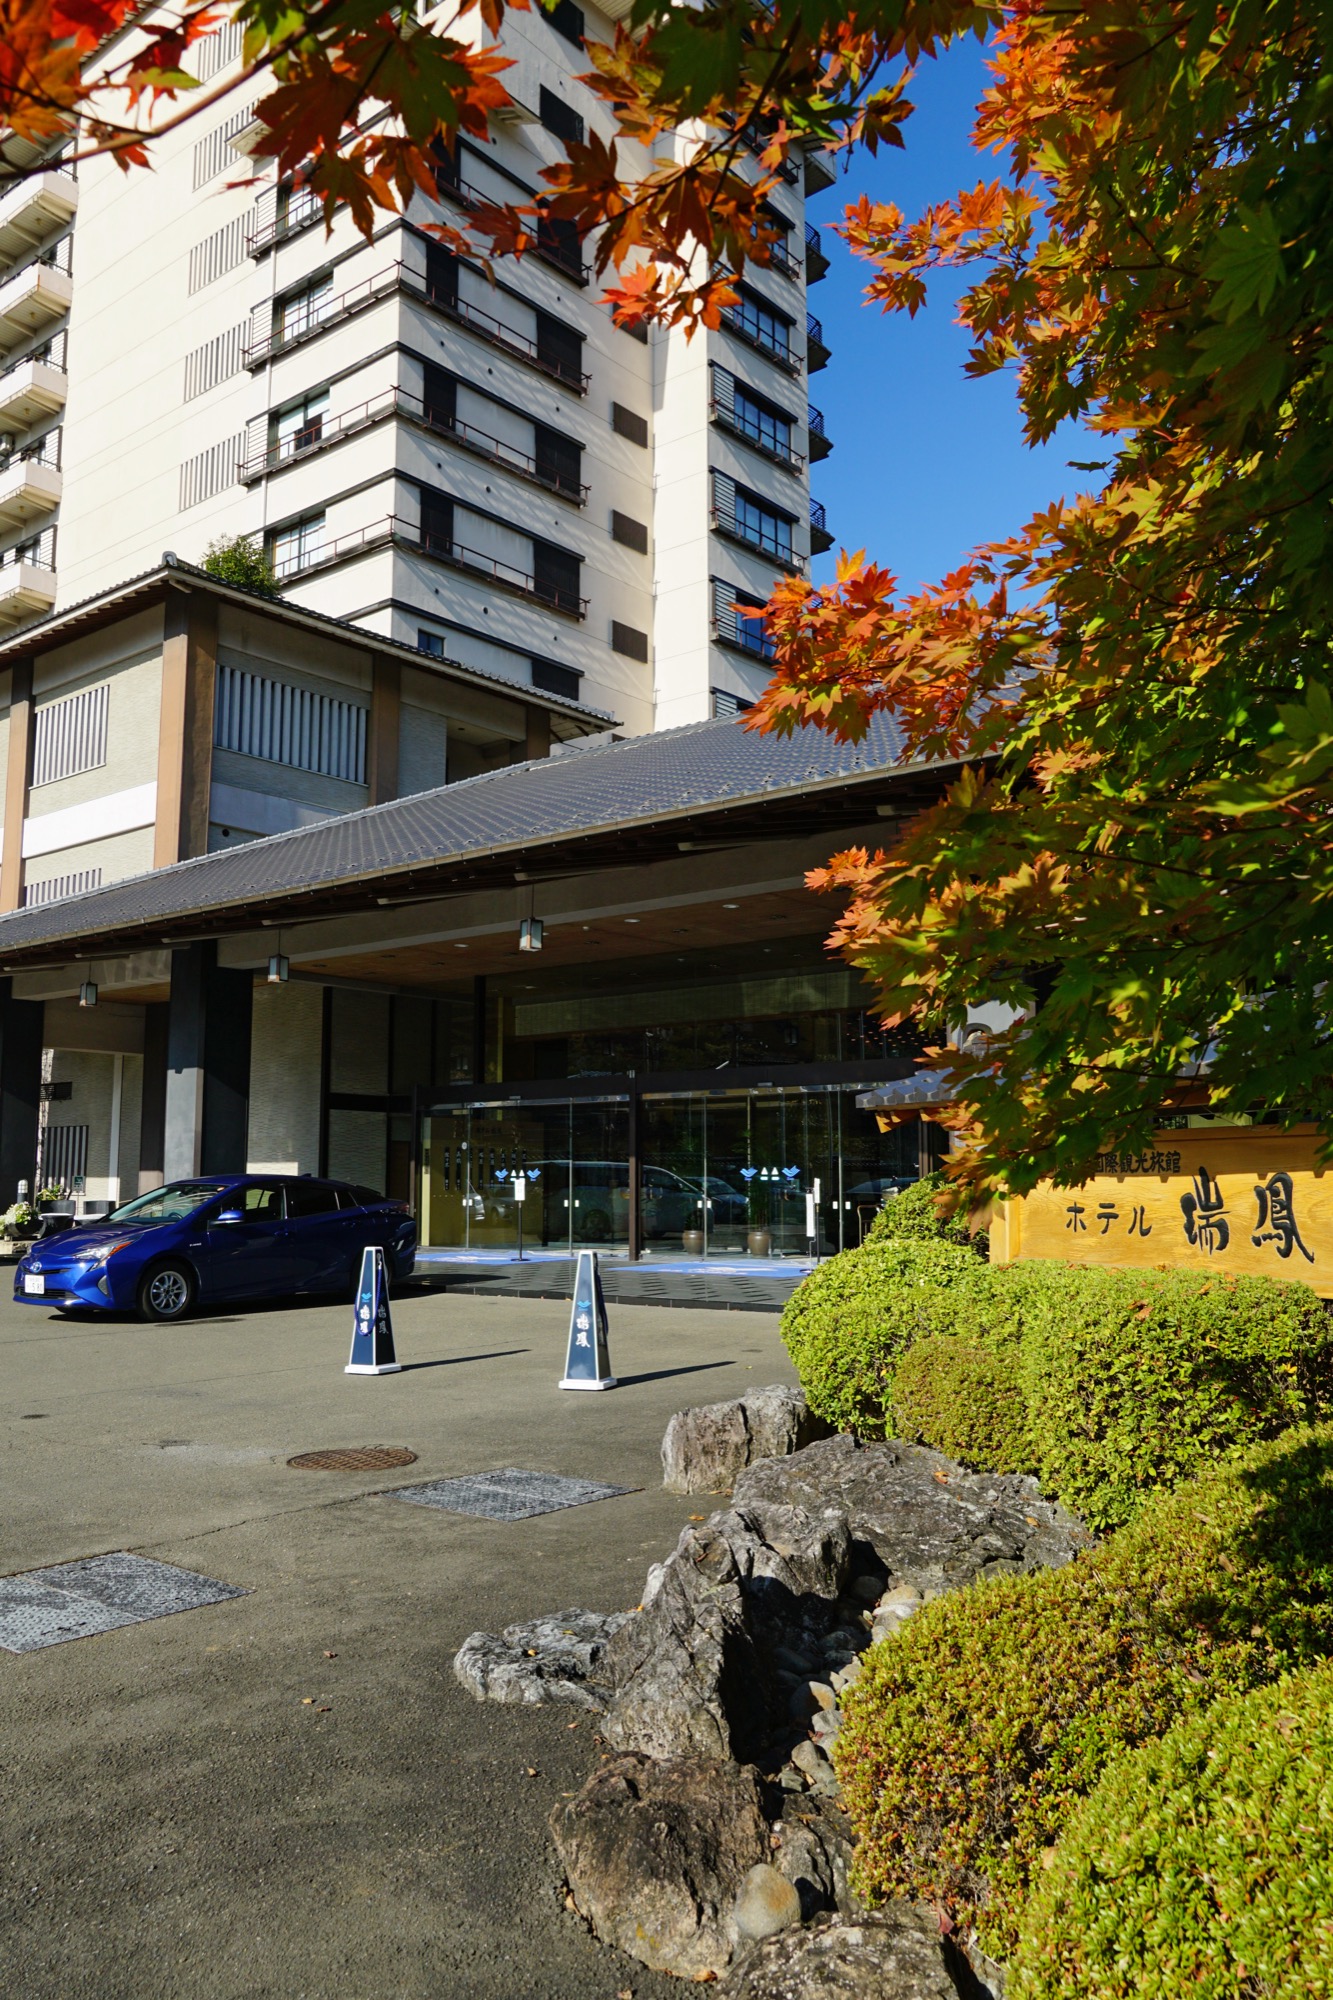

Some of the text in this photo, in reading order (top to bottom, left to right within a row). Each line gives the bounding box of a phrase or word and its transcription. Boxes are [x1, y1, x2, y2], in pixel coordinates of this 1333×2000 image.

[1065, 1166, 1315, 1264] ホテル 瑞鳳
